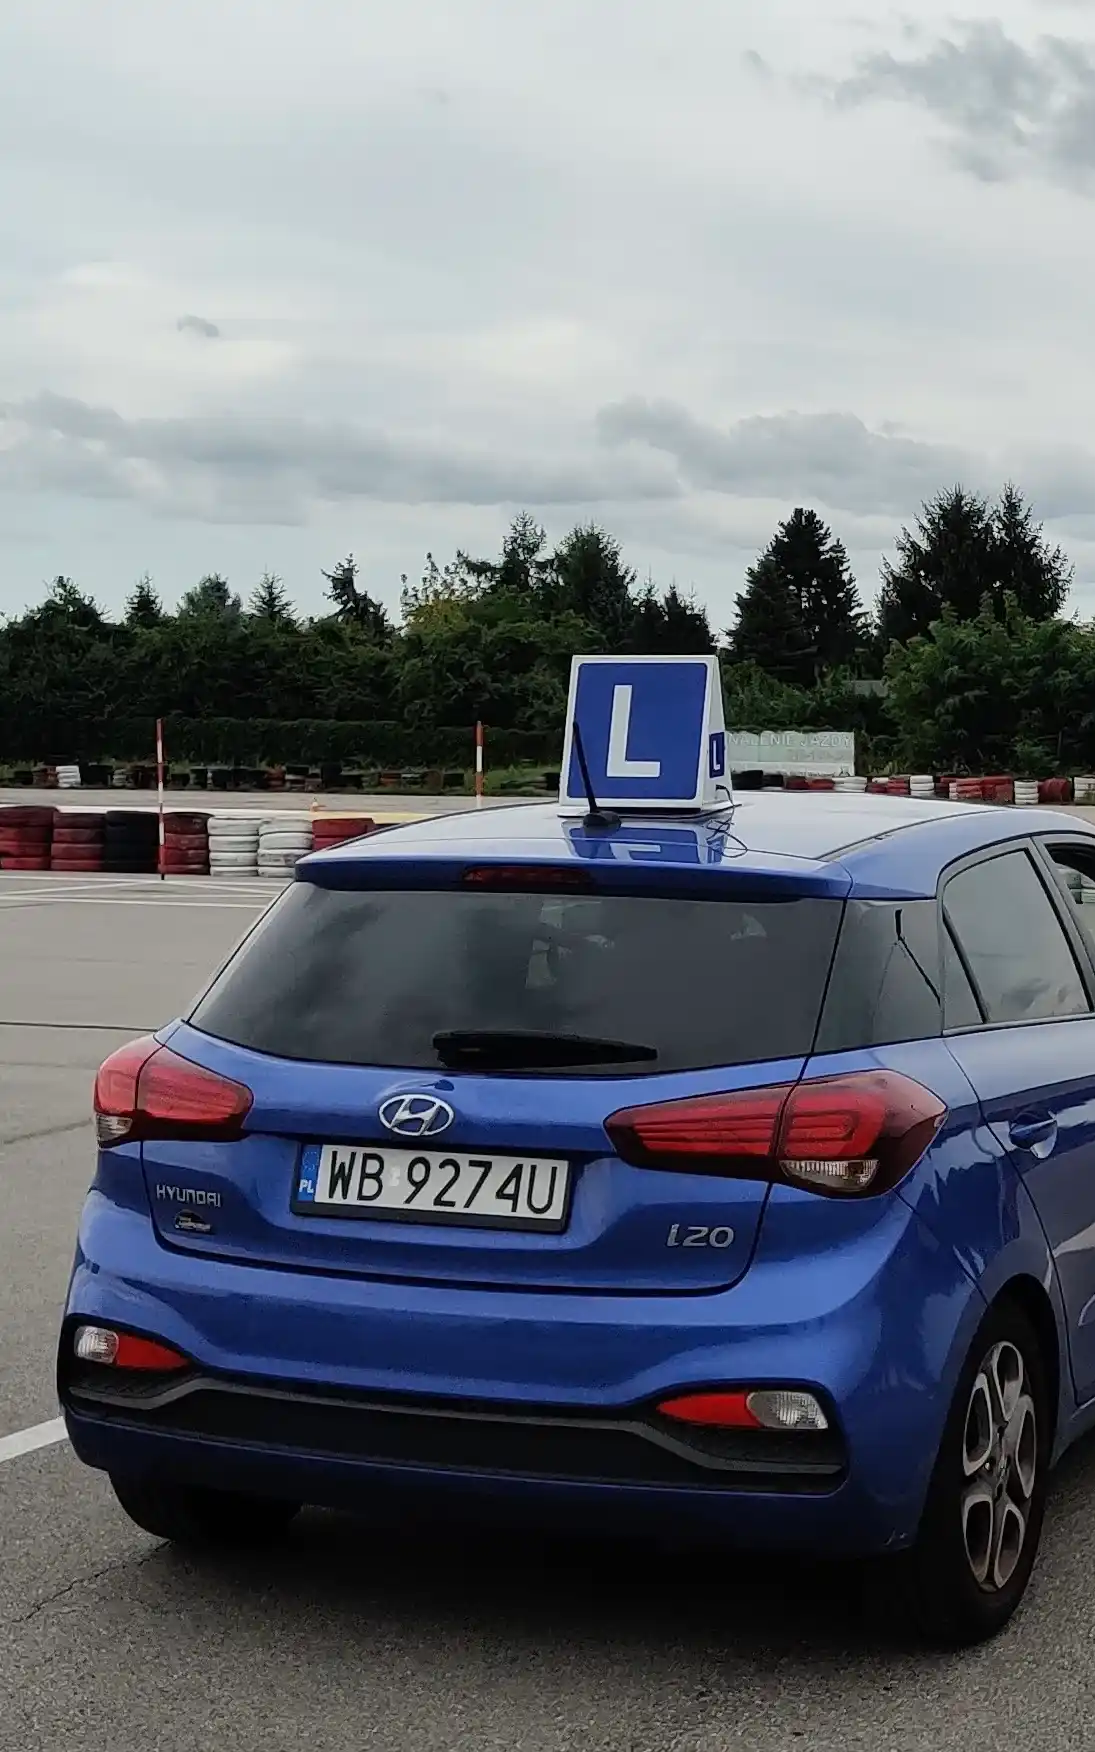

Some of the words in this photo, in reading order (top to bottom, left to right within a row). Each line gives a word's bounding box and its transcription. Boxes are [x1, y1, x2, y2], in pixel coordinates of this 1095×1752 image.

[607, 684, 660, 777] L
[712, 740, 721, 770] L
[156, 1184, 221, 1207] HYUNDAI
[299, 1179, 314, 1193] PL
[329, 1151, 384, 1201] WB
[403, 1156, 558, 1214] 9274U
[667, 1224, 734, 1248] i20
